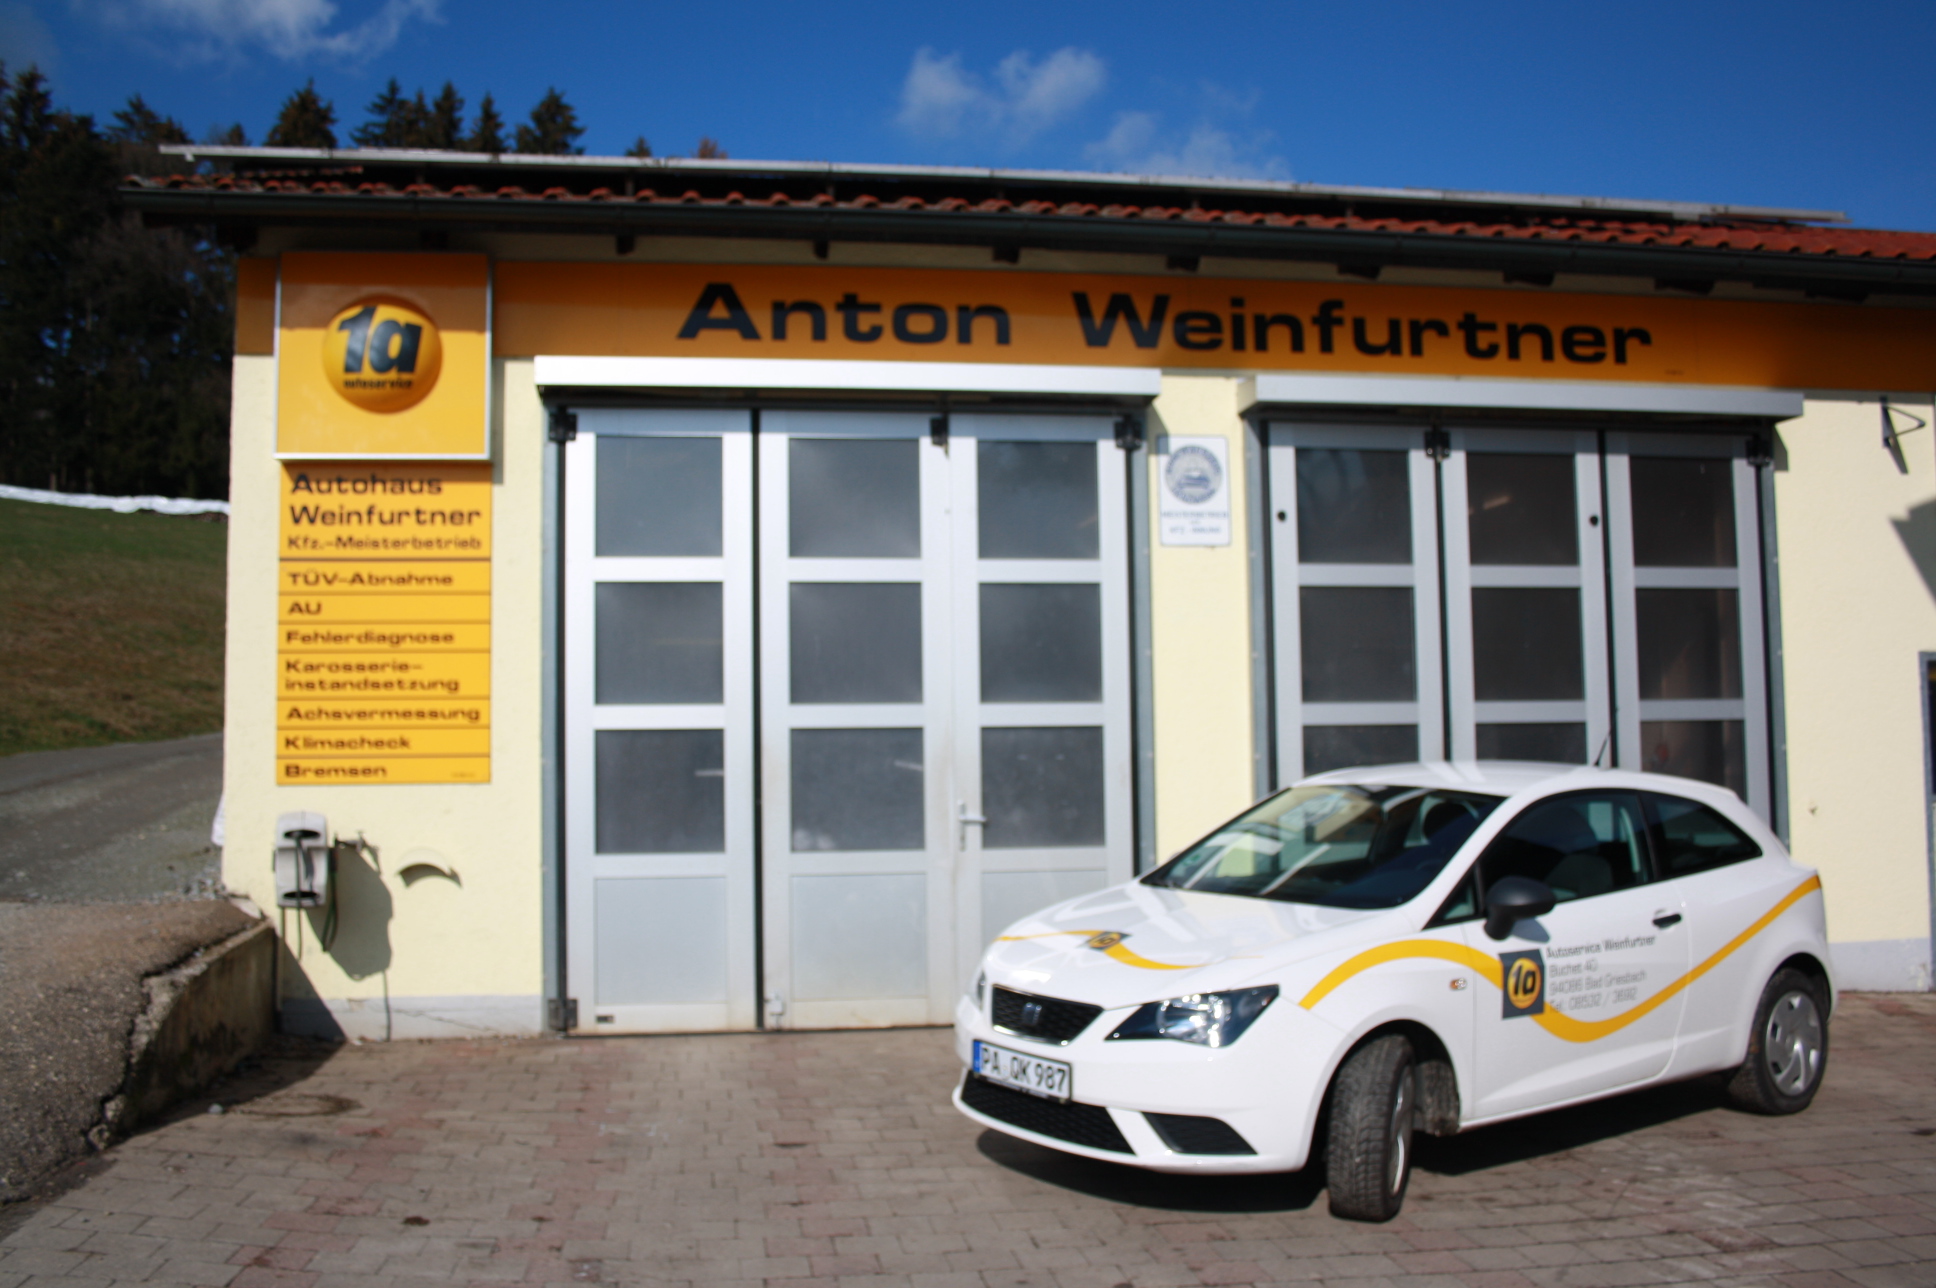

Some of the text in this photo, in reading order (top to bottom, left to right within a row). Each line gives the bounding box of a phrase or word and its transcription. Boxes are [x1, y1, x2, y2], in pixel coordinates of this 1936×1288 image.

[676, 282, 1653, 365] Anton Weinfurtner
[338, 305, 423, 374] 1a
[291, 473, 443, 495] Autohaus
[289, 504, 482, 526] Weinfurtner
[287, 534, 482, 551] Kfz.-Meisterbetrieb
[288, 567, 454, 586] TÜV-Abnahme
[288, 602, 322, 616] AU
[286, 630, 455, 647] Fehlerdiagnose
[286, 660, 423, 674] Karosserie-
[285, 679, 460, 694] instandsetzung
[286, 707, 481, 723] Achsvermessung
[285, 736, 411, 750] Klimacheck
[284, 765, 388, 778] Bremsen
[1545, 936, 1657, 959] Autoservice Weinfurtner
[1585, 976, 1603, 991] Bad
[982, 1047, 1002, 1074] PA
[1011, 1056, 1032, 1085] QK
[1035, 1063, 1067, 1093] 987
